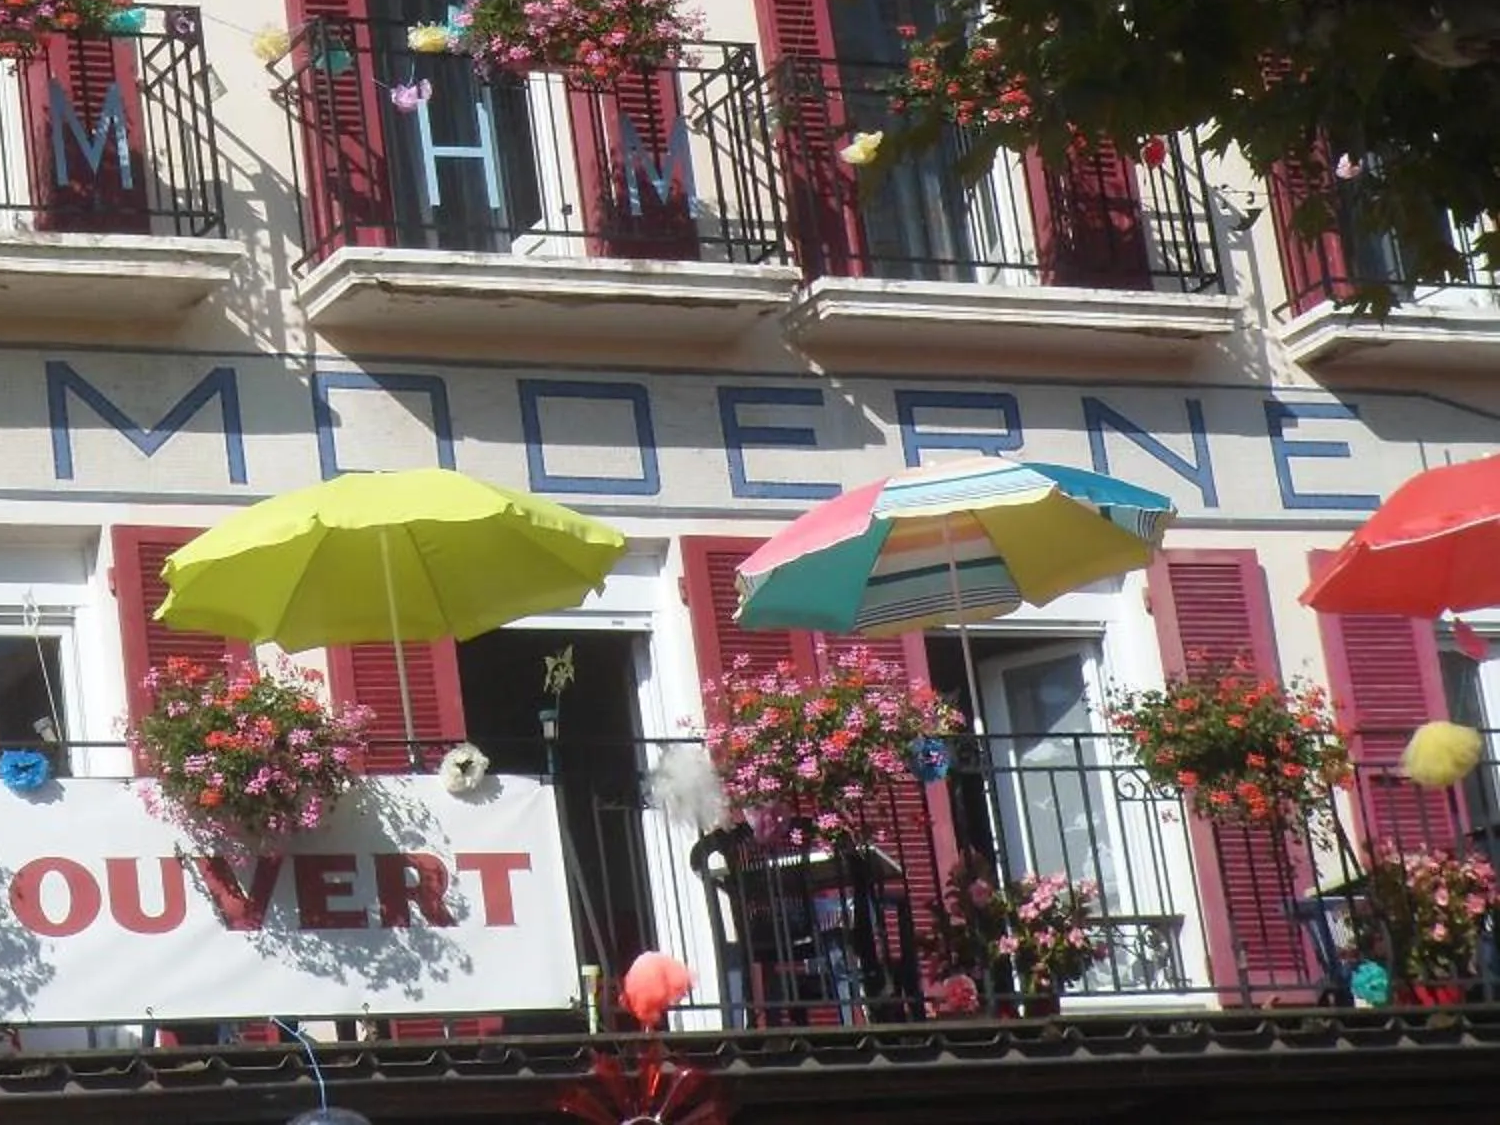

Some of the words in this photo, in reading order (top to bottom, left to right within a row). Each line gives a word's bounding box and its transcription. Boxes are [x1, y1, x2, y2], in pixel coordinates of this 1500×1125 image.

[49, 78, 133, 190] M
[417, 99, 500, 209] H
[617, 115, 699, 219] M
[45, 361, 1381, 510] MODERNE
[10, 852, 532, 937] OUVERT
